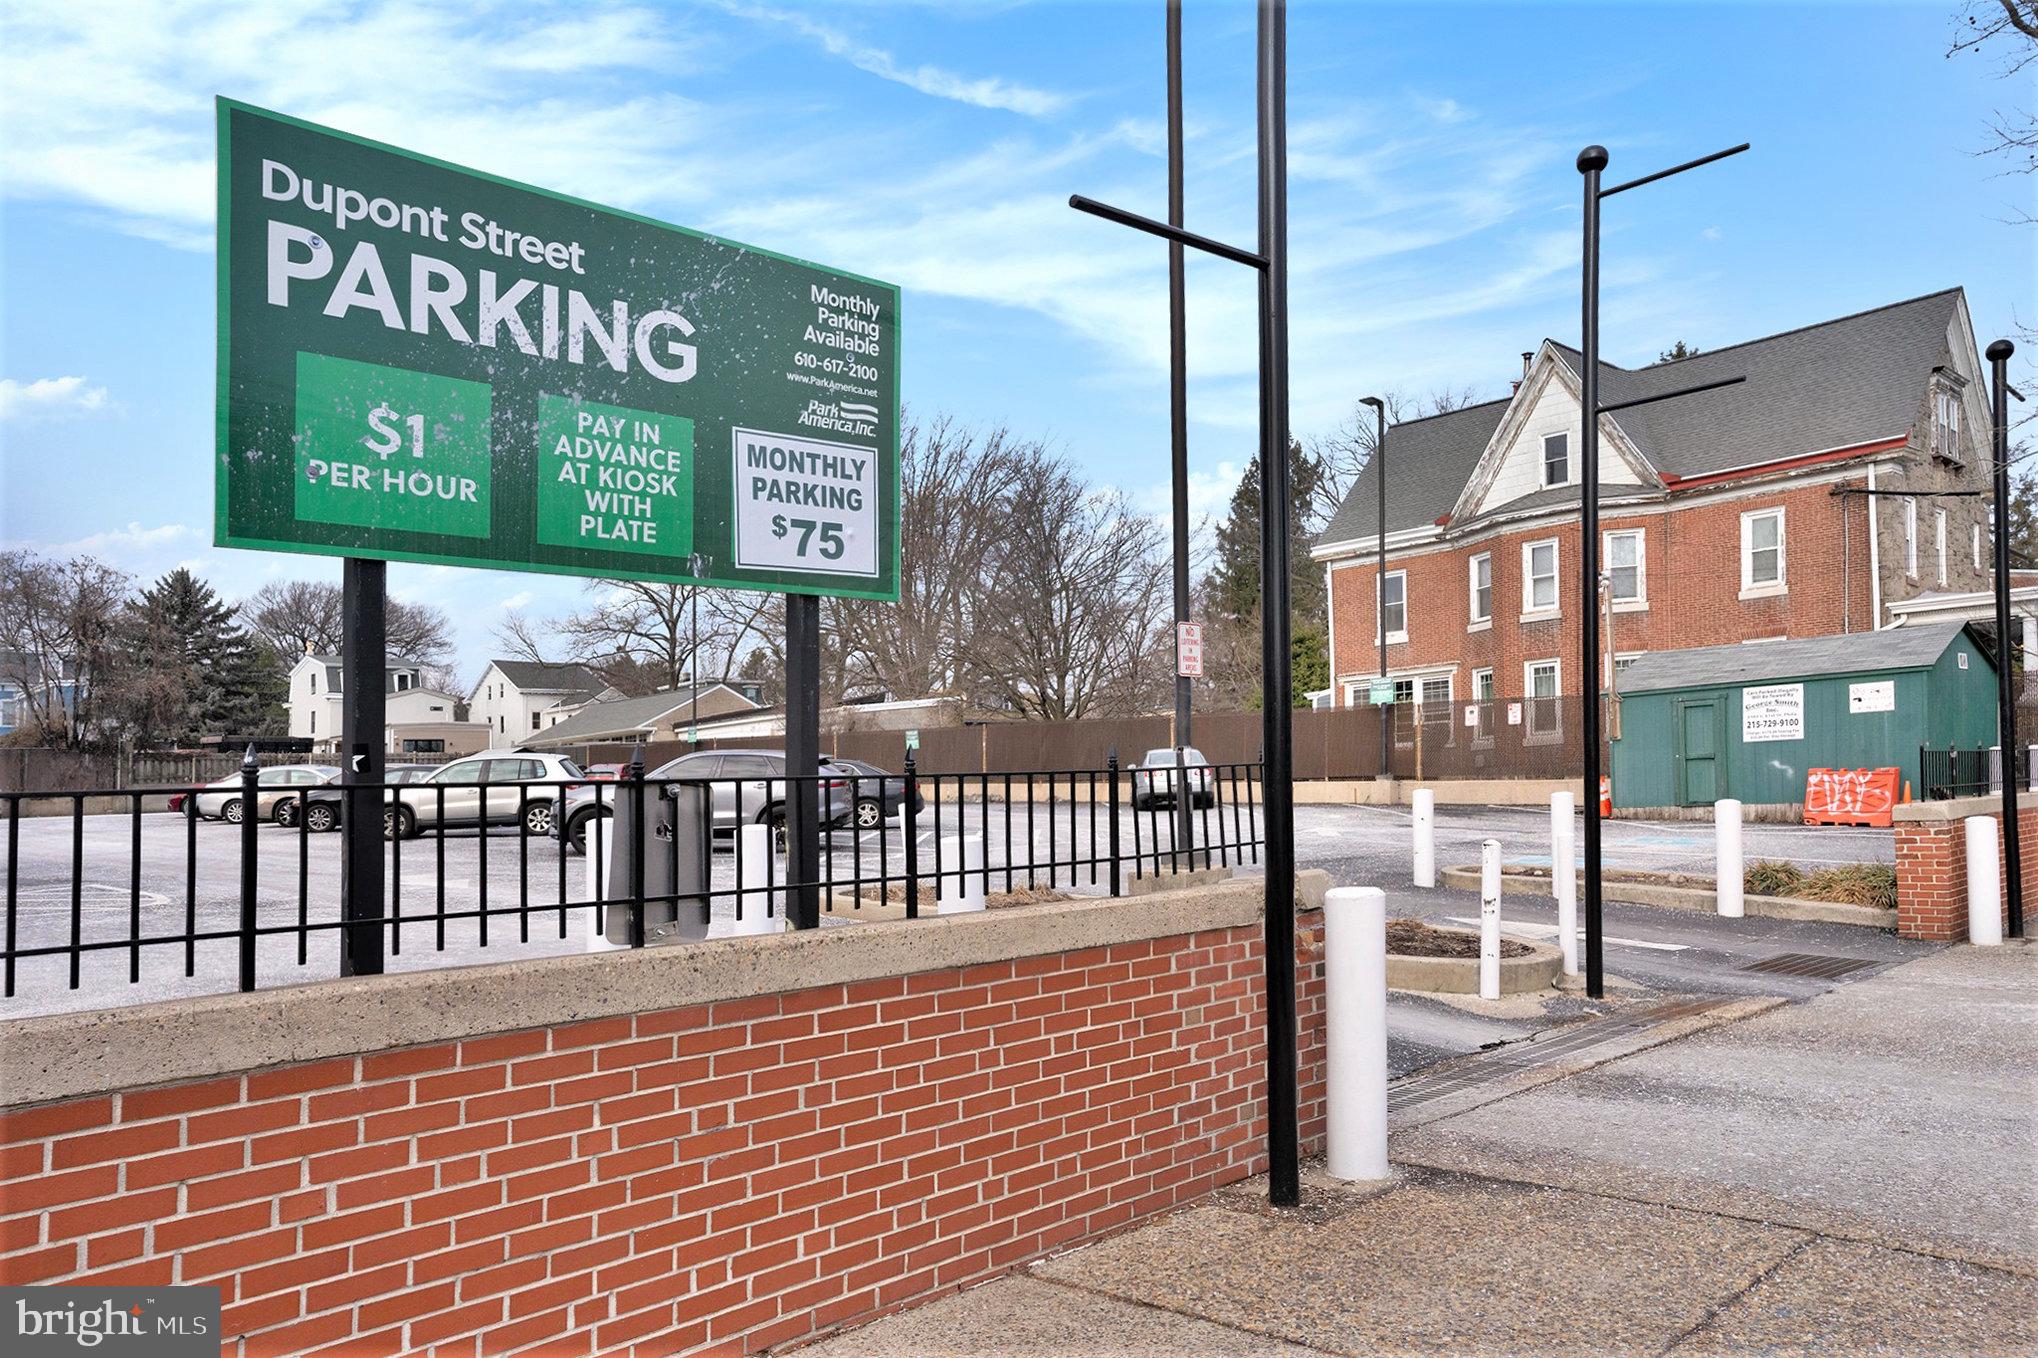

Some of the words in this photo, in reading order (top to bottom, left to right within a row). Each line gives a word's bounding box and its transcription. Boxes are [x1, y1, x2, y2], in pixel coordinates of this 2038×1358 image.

[262, 158, 448, 242] Dupont
[459, 212, 585, 275] Street
[267, 219, 697, 383] PARKING
[811, 284, 880, 322] Monthly
[803, 325, 880, 356] Available
[818, 307, 880, 341] Parking
[794, 351, 878, 381] 610-617-2100
[786, 372, 878, 397] www.ParkAmerica.net
[808, 400, 839, 418] Park
[362, 402, 424, 460] $1
[578, 412, 626, 438] PAY
[634, 421, 660, 445] IN
[554, 434, 681, 473] ADVANCE
[747, 444, 866, 482] MONTHLY
[309, 459, 371, 490] PER
[383, 468, 478, 503] HOUR
[557, 461, 591, 485] AT
[599, 465, 678, 497] KIOSK
[752, 476, 863, 512] PARKING
[584, 489, 652, 518] WITH
[580, 515, 657, 544] PLATE
[771, 514, 845, 560] $75
[1746, 718, 1799, 729] 215-729-9100
